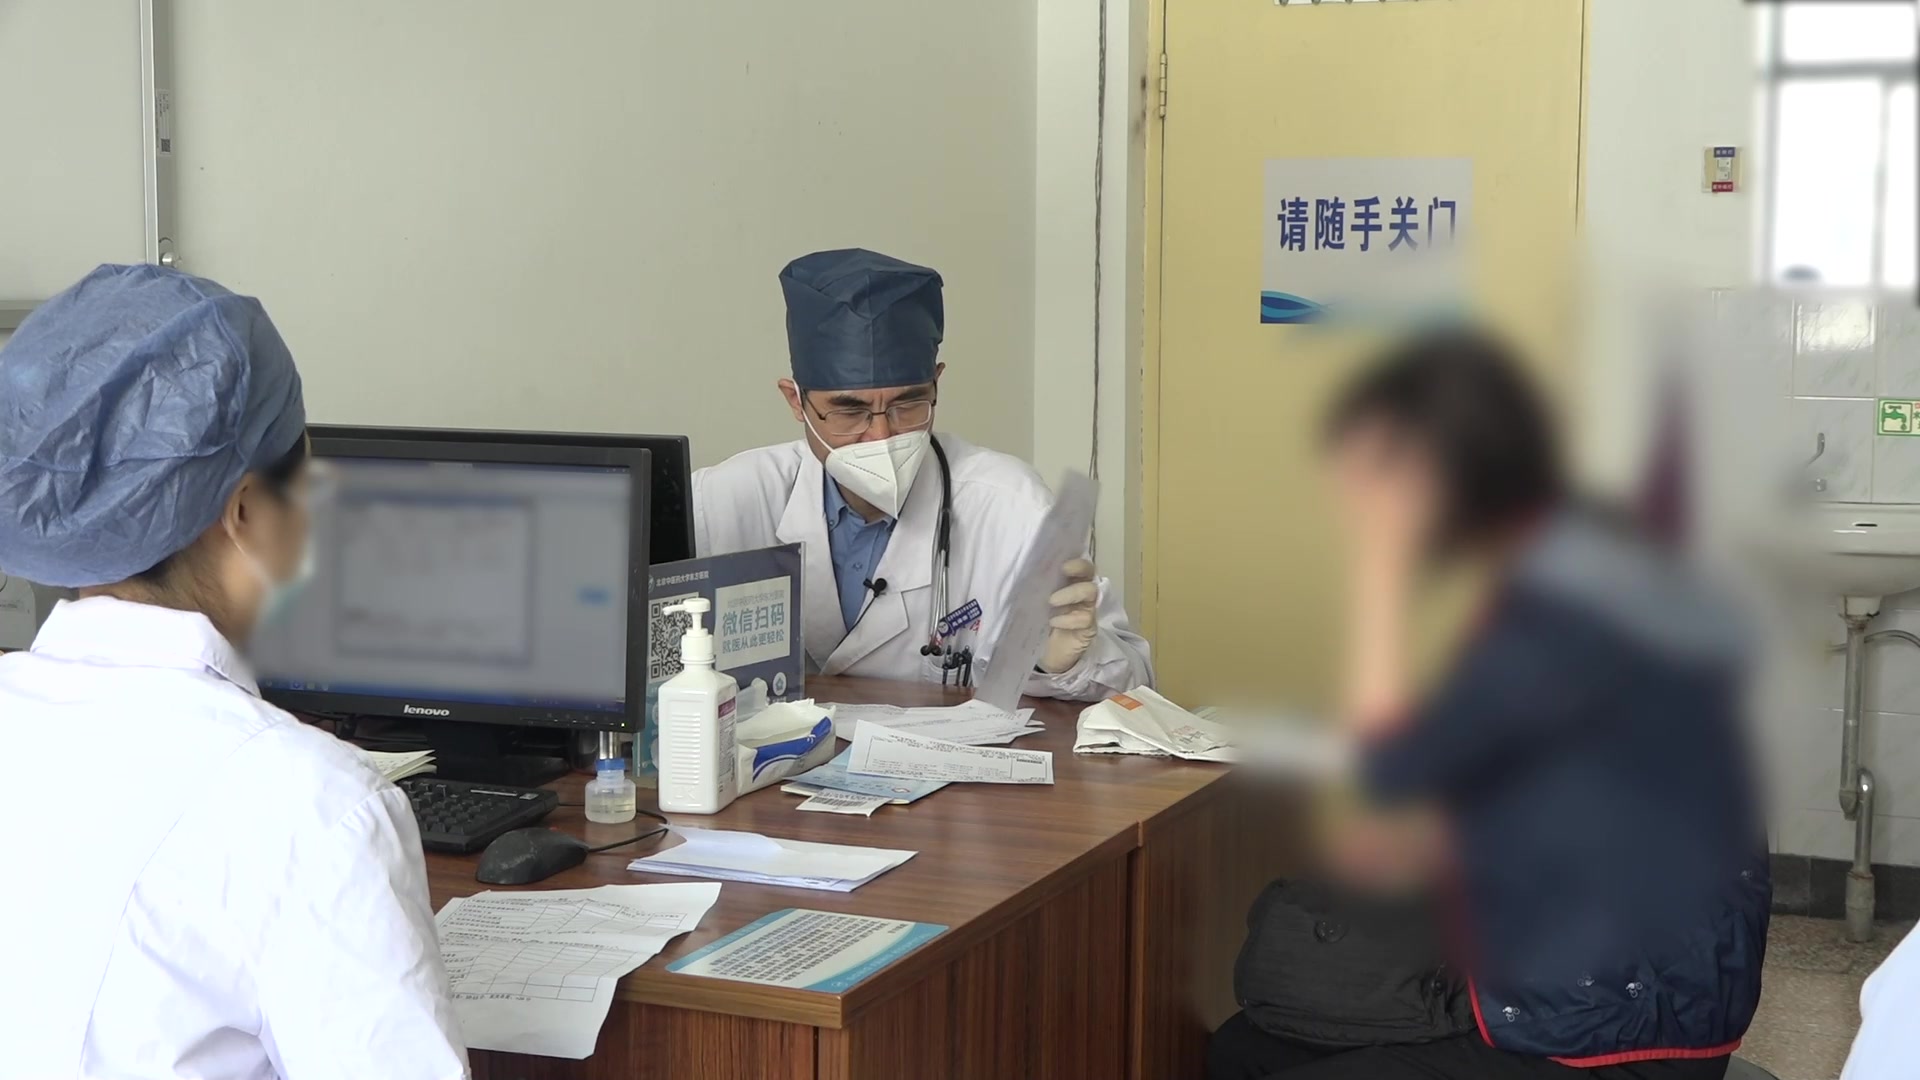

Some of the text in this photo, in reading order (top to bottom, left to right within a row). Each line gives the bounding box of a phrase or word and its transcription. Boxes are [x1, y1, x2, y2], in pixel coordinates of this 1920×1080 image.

[1277, 196, 1456, 252] 请随手关门
[722, 602, 784, 637] 微信扫码
[722, 629, 784, 654] 就医从此更轻松
[403, 704, 450, 716] lenovo
